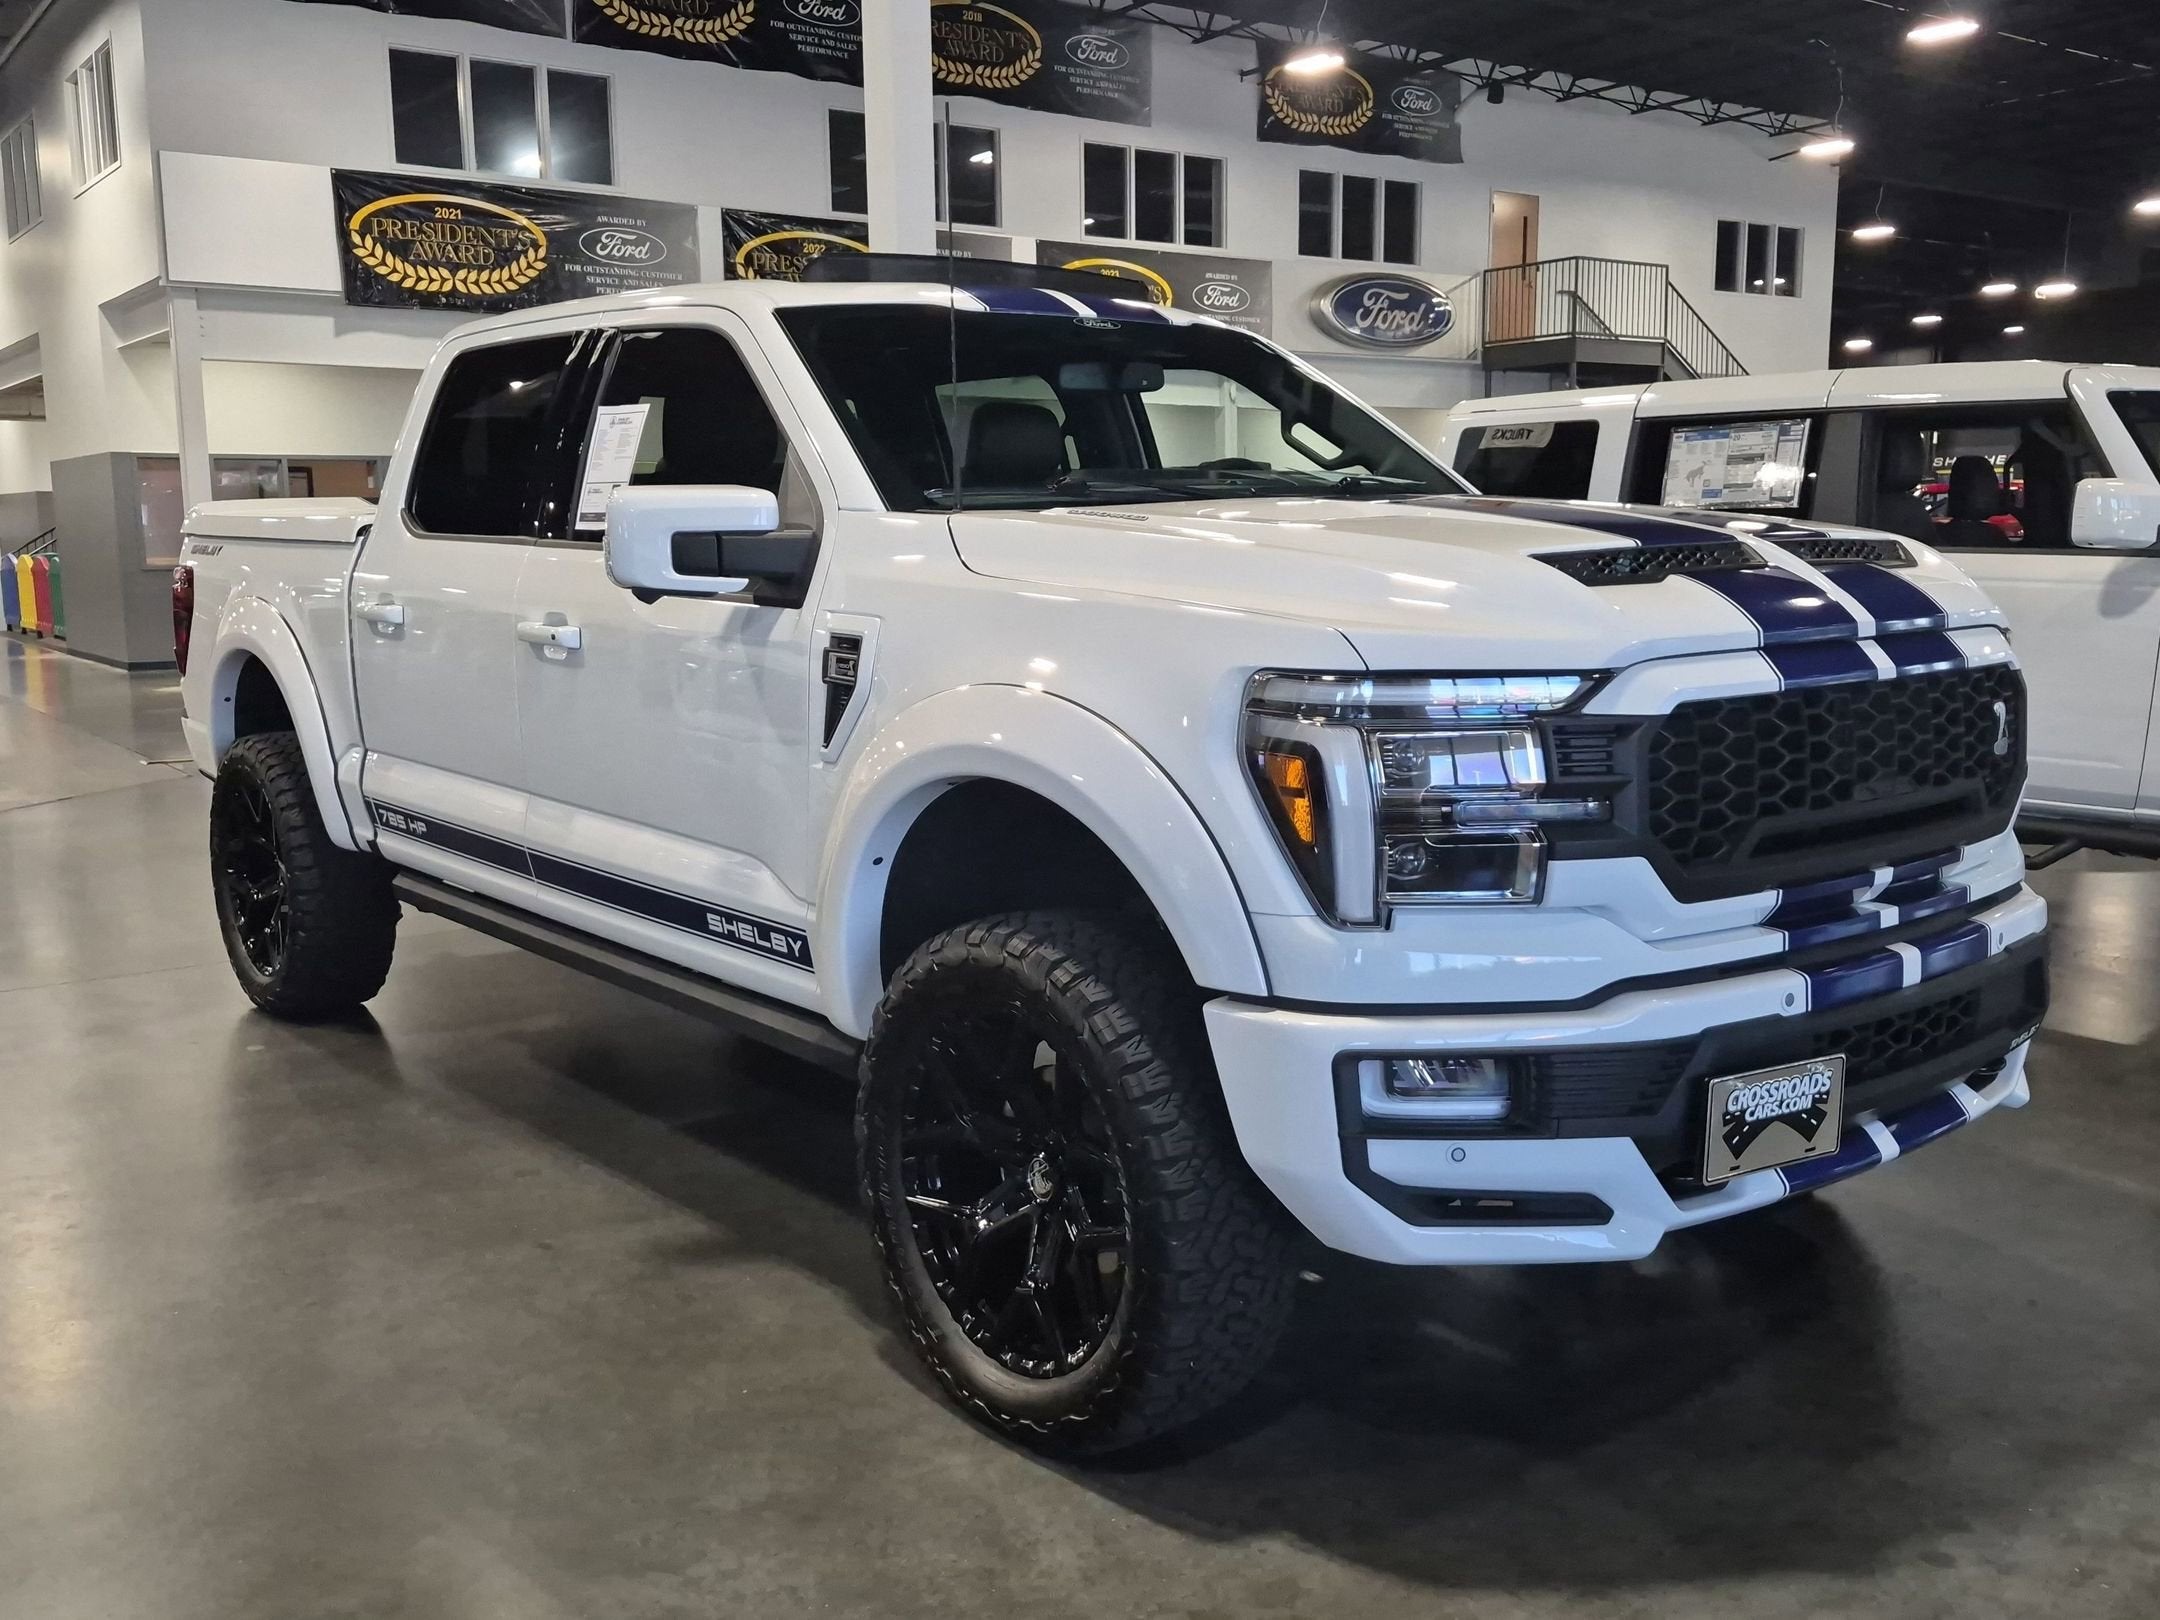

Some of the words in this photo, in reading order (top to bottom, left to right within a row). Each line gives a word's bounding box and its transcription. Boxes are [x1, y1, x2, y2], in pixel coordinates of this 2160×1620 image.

[798, 0, 847, 21] Ford
[962, 10, 983, 22] 2018
[770, 19, 785, 29] FOR
[786, 23, 836, 37] OUTSTANDING
[837, 31, 862, 42] CUSTO
[789, 33, 819, 44] SERVICE
[822, 38, 835, 47] AND
[836, 41, 857, 51] SALES
[931, 19, 1030, 50] RESIDENT'S
[797, 44, 849, 59] PERFORMANCE
[943, 38, 1005, 63] AWARD
[1077, 38, 1119, 64] Ford
[1400, 88, 1433, 111] Ford
[434, 207, 462, 220] 2021
[596, 215, 636, 226] AWARDED
[636, 219, 646, 227] BY
[370, 217, 532, 250] PRESIDENT'S
[596, 231, 651, 259] Ford
[408, 240, 495, 266] AWARD
[802, 242, 836, 254] 2022
[564, 263, 582, 272] FOR
[583, 265, 640, 277] OUTSTANDING
[641, 270, 683, 280] CUSTOMER
[586, 275, 619, 285] SERVICE
[623, 279, 639, 287] AND
[1203, 285, 1240, 307] Ford
[1355, 287, 1427, 332] Ford
[407, 817, 428, 835] HP
[706, 912, 803, 958] SHELBY
[1726, 1069, 1833, 1113] CROSSROADS
[1744, 1094, 1813, 1122] CARS.COM
